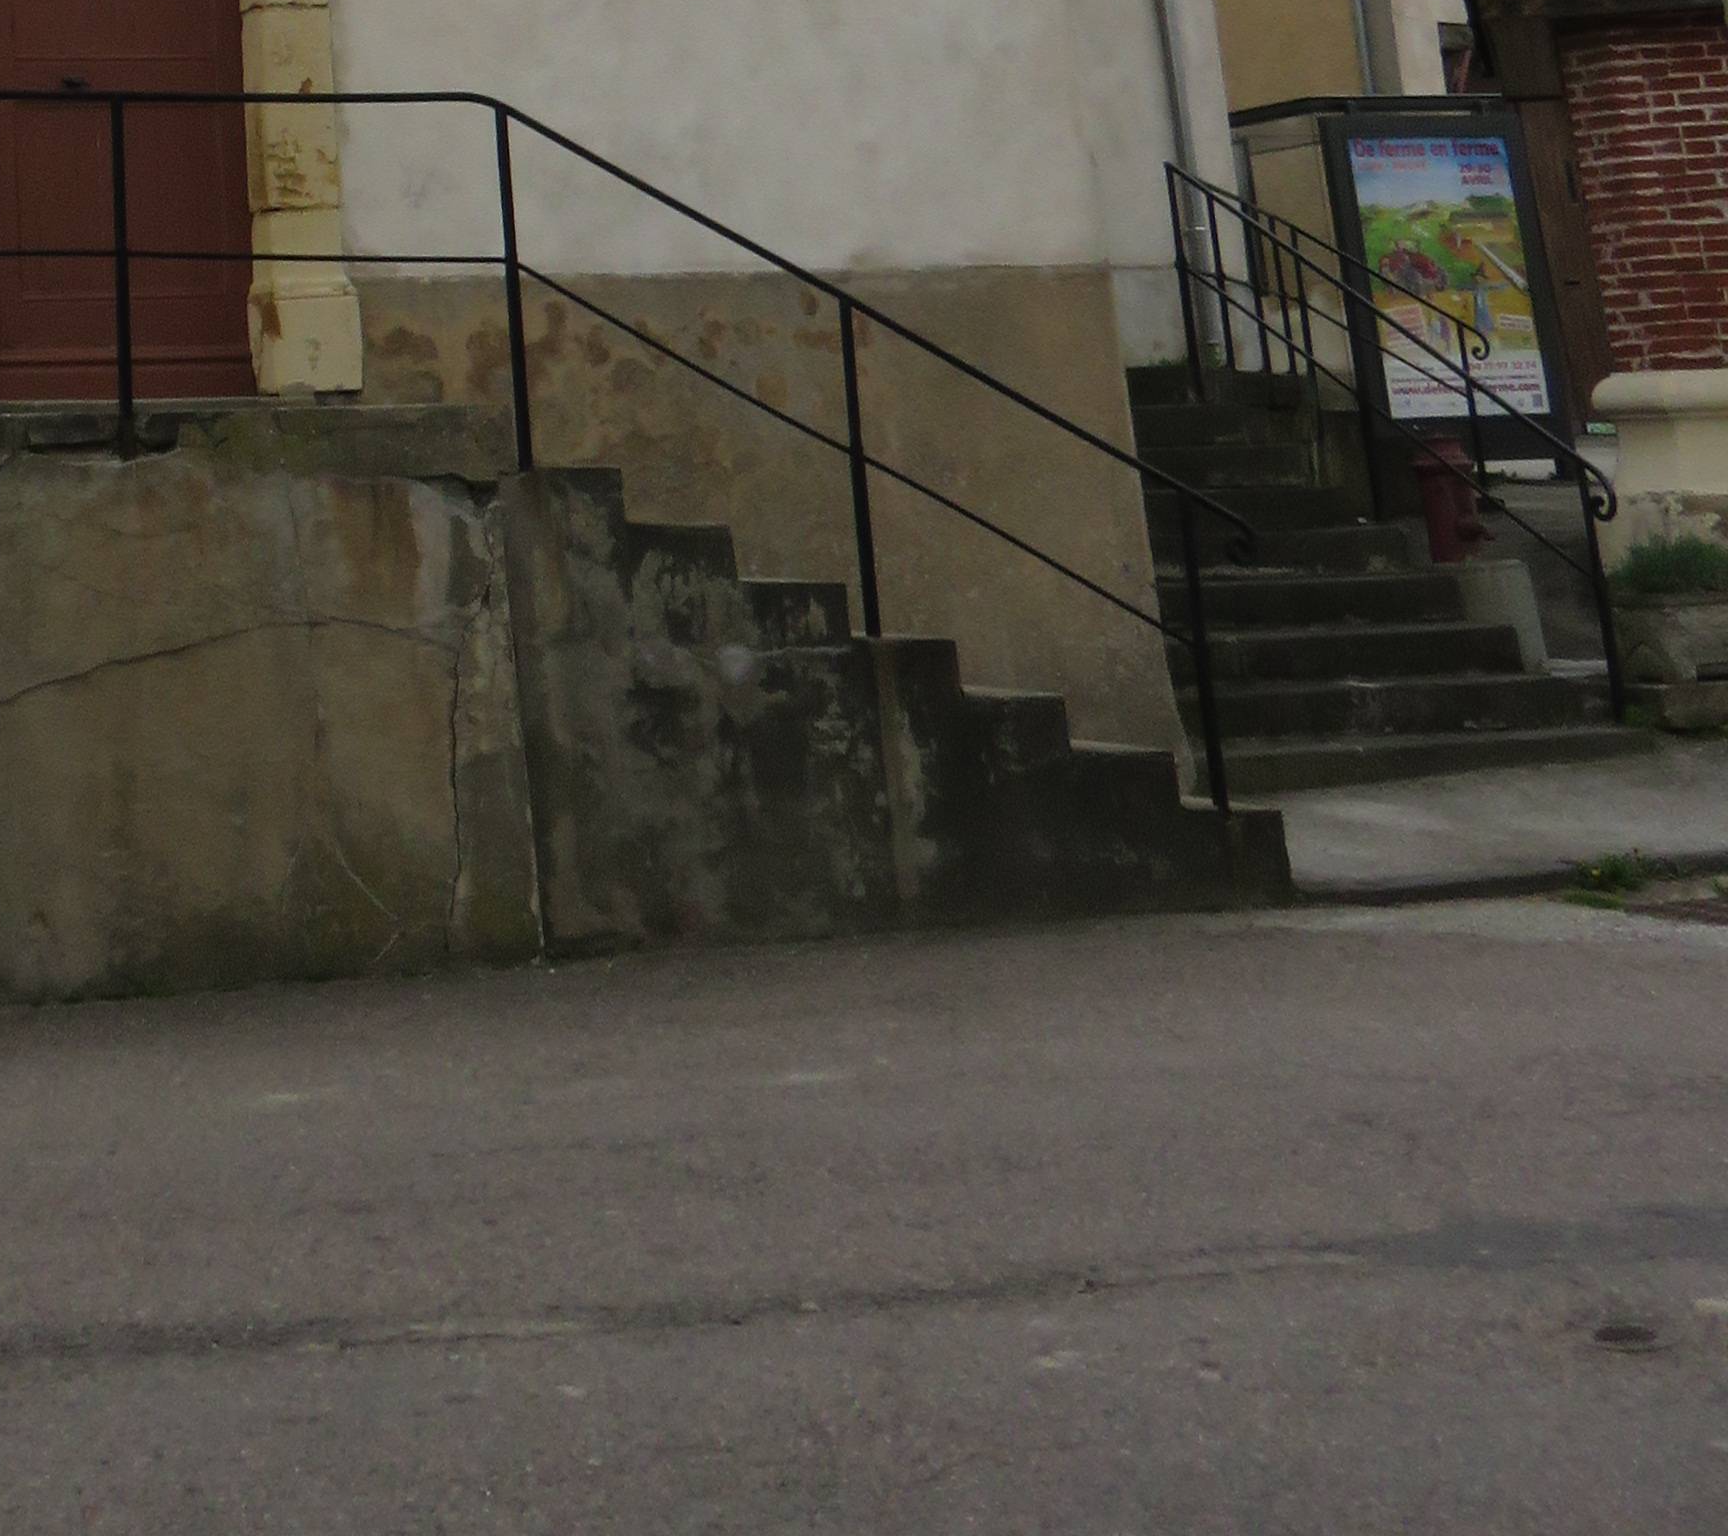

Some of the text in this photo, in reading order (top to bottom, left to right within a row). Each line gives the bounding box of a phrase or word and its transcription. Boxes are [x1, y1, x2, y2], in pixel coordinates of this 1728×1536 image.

[1354, 137, 1500, 158] De ferme en ferme
